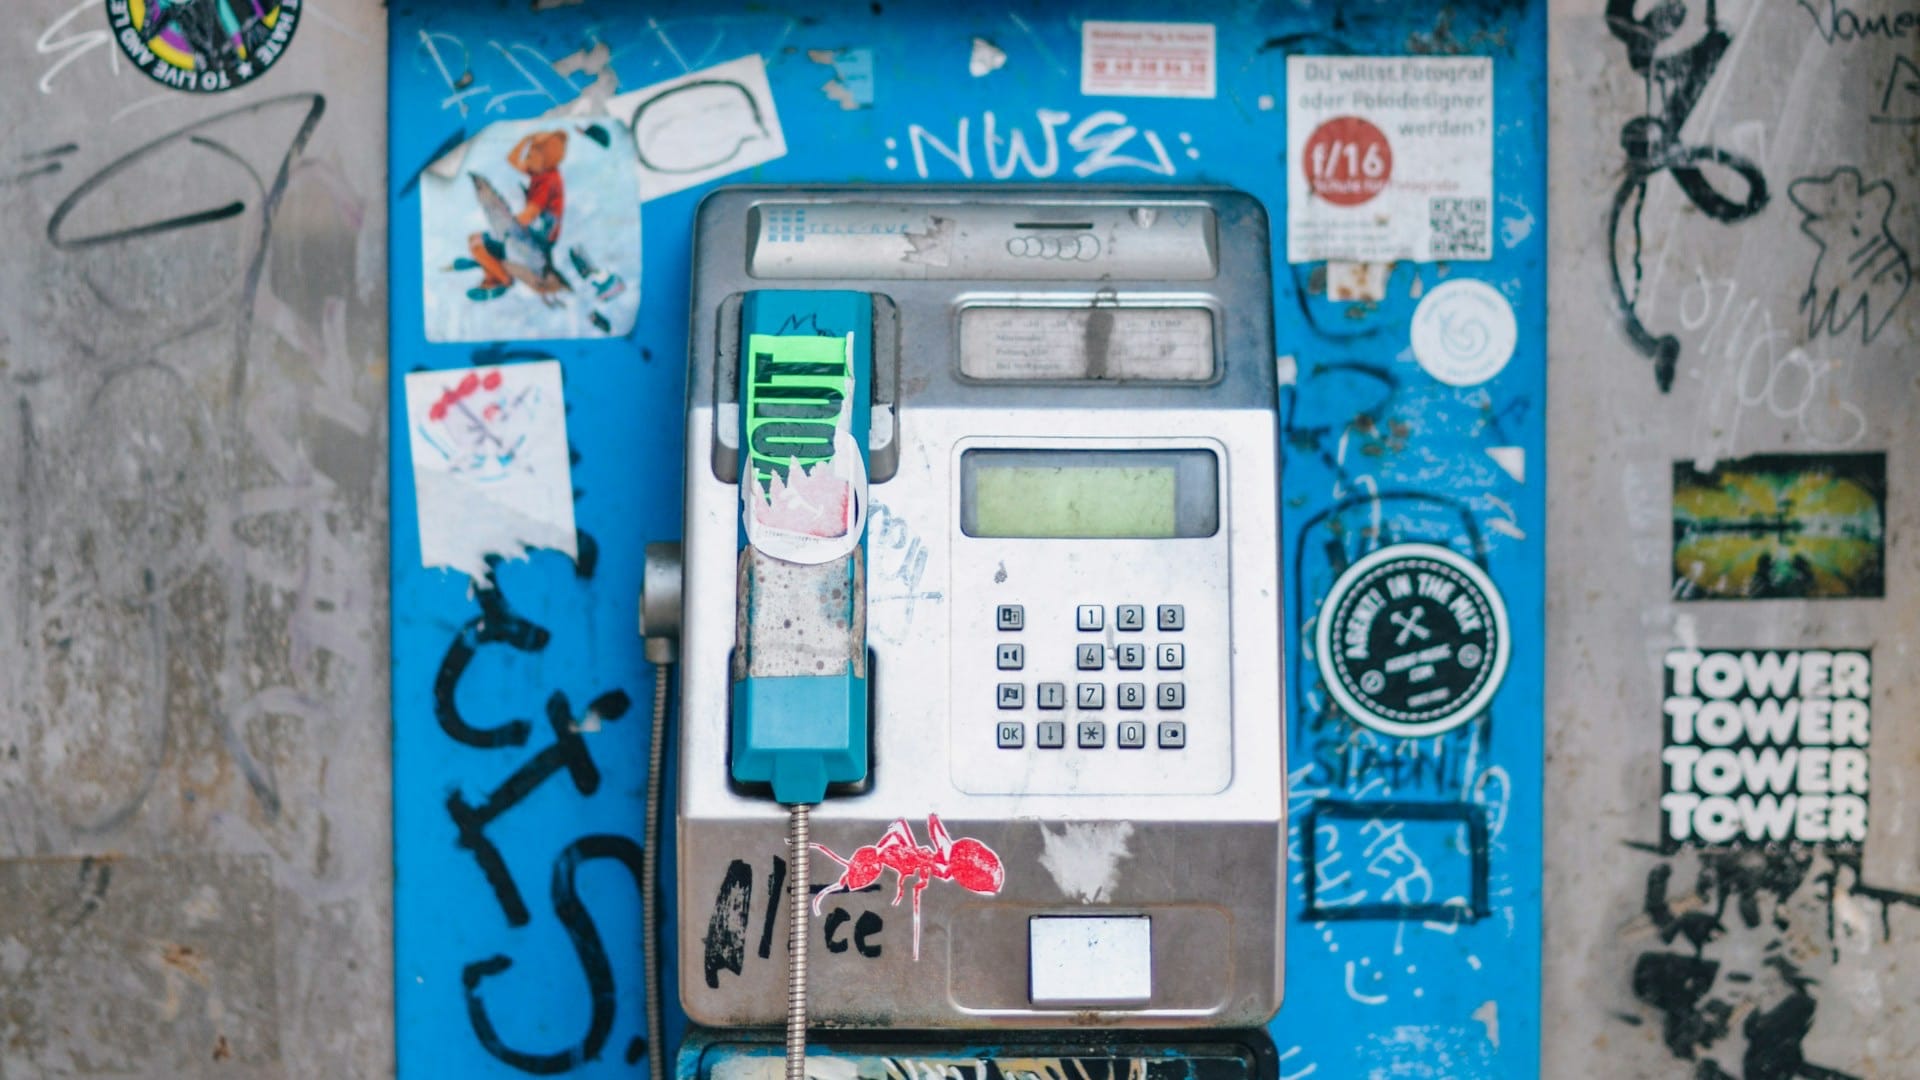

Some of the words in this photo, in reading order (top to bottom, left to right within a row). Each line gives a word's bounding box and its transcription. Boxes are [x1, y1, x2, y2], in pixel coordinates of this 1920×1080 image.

[120, 27, 155, 66] AND
[255, 12, 296, 66] HATE
[153, 60, 198, 90] LIVE
[202, 69, 231, 91] TO
[1304, 64, 1332, 81] Du
[1338, 63, 1396, 81] willst
[1402, 63, 1486, 85] Fotograf
[1299, 89, 1344, 109] oder
[1398, 118, 1486, 137] werden?
[1312, 138, 1385, 178] f/16
[1126, 609, 1136, 624] 2
[1167, 609, 1176, 624] 3
[1386, 573, 1413, 600] IN
[1417, 572, 1457, 605] THE
[1449, 594, 1483, 635] MIX
[1085, 648, 1095, 663] 4
[1126, 648, 1135, 663] 5
[1166, 648, 1175, 663] 6
[1664, 651, 1871, 699] TOWER
[1086, 687, 1095, 703] 7
[1127, 687, 1136, 703] 8
[1166, 687, 1176, 703] 9
[1002, 727, 1019, 741] OK
[1126, 726, 1136, 742] 0
[1663, 697, 1871, 746] TOWER
[1662, 746, 1870, 795] TOWER
[1660, 793, 1868, 843] TOWER
